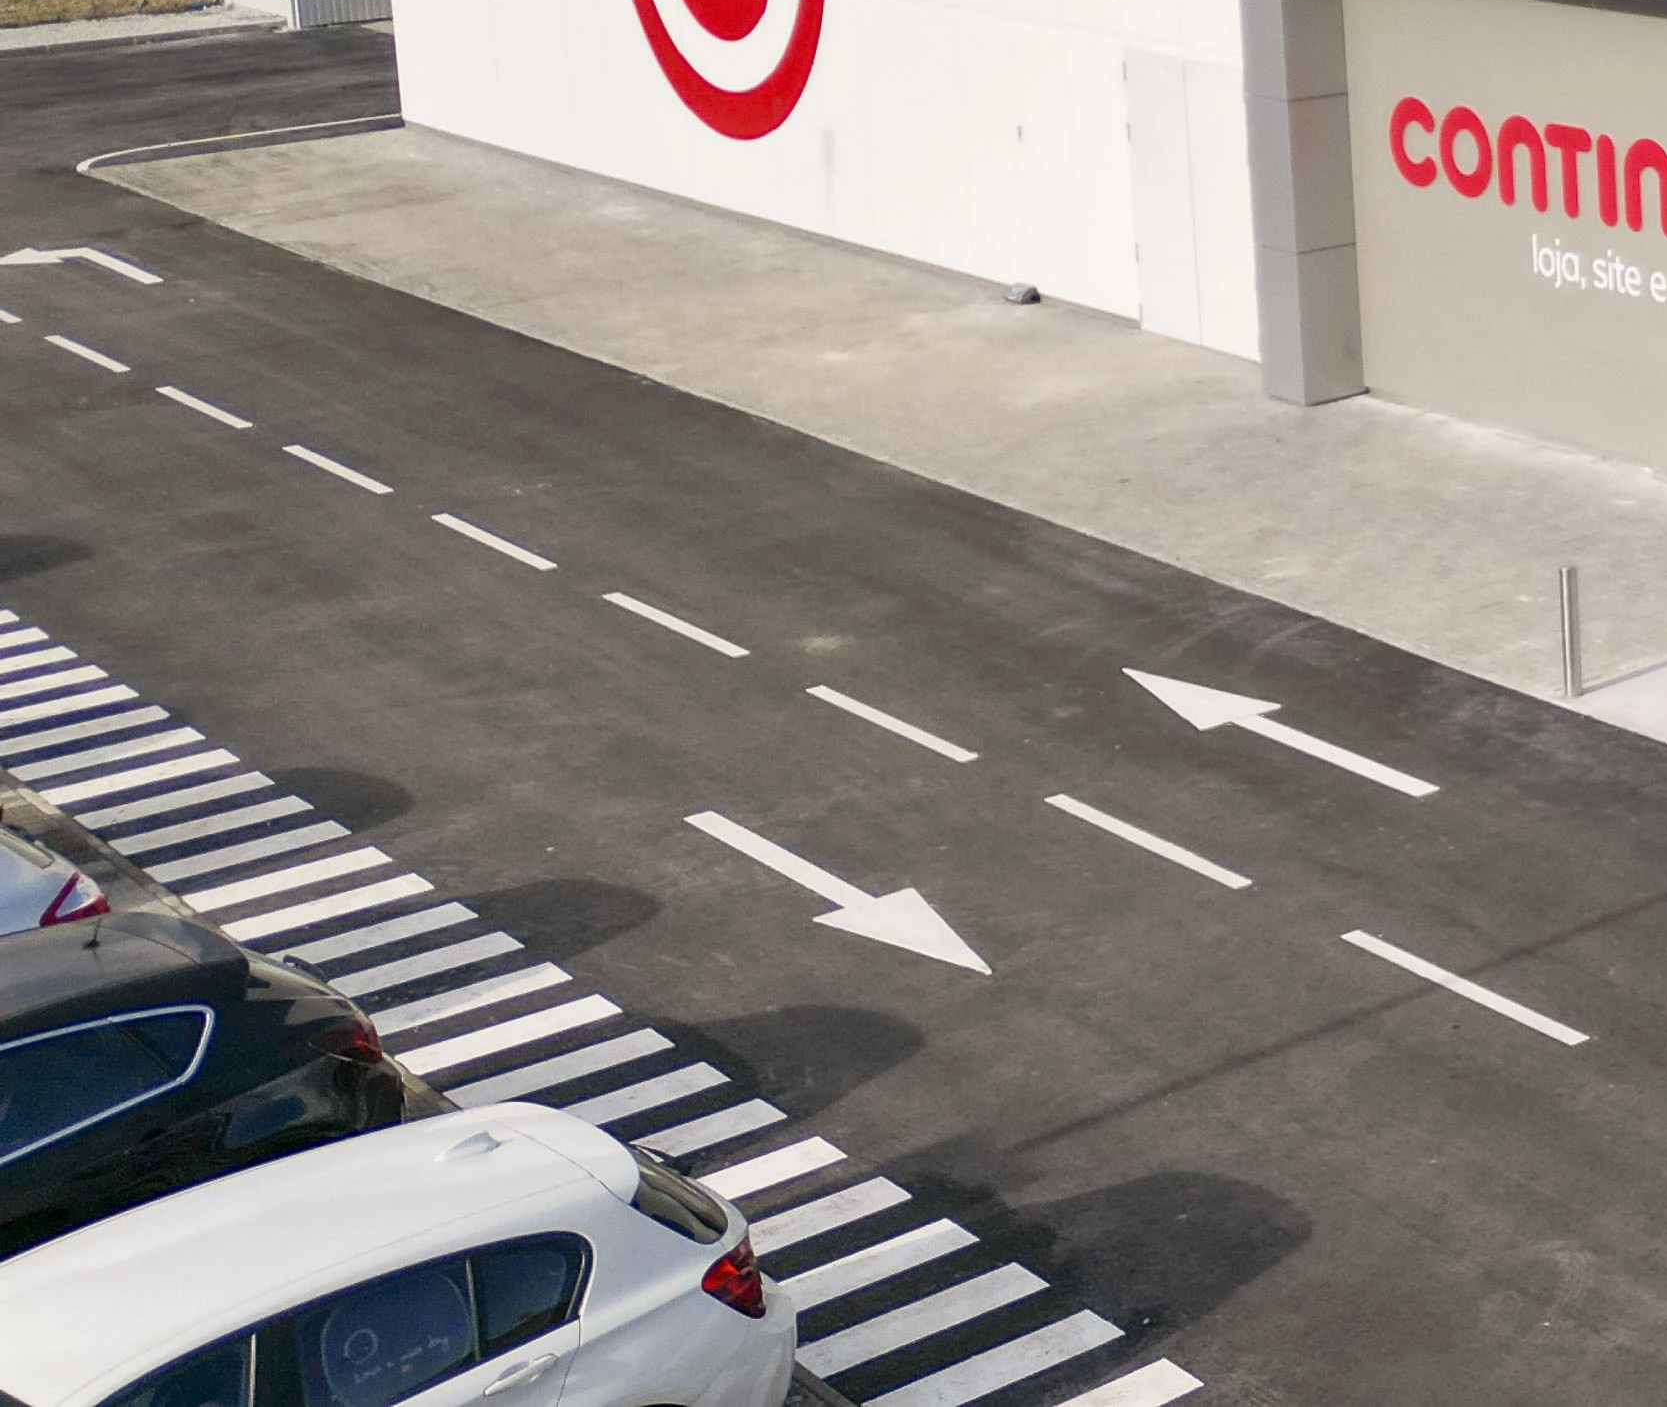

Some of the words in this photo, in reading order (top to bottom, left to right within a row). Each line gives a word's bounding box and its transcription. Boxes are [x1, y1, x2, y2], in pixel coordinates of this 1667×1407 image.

[1530, 232, 1587, 290] loja,
[1592, 250, 1642, 297] site
[1649, 271, 1667, 302] e
